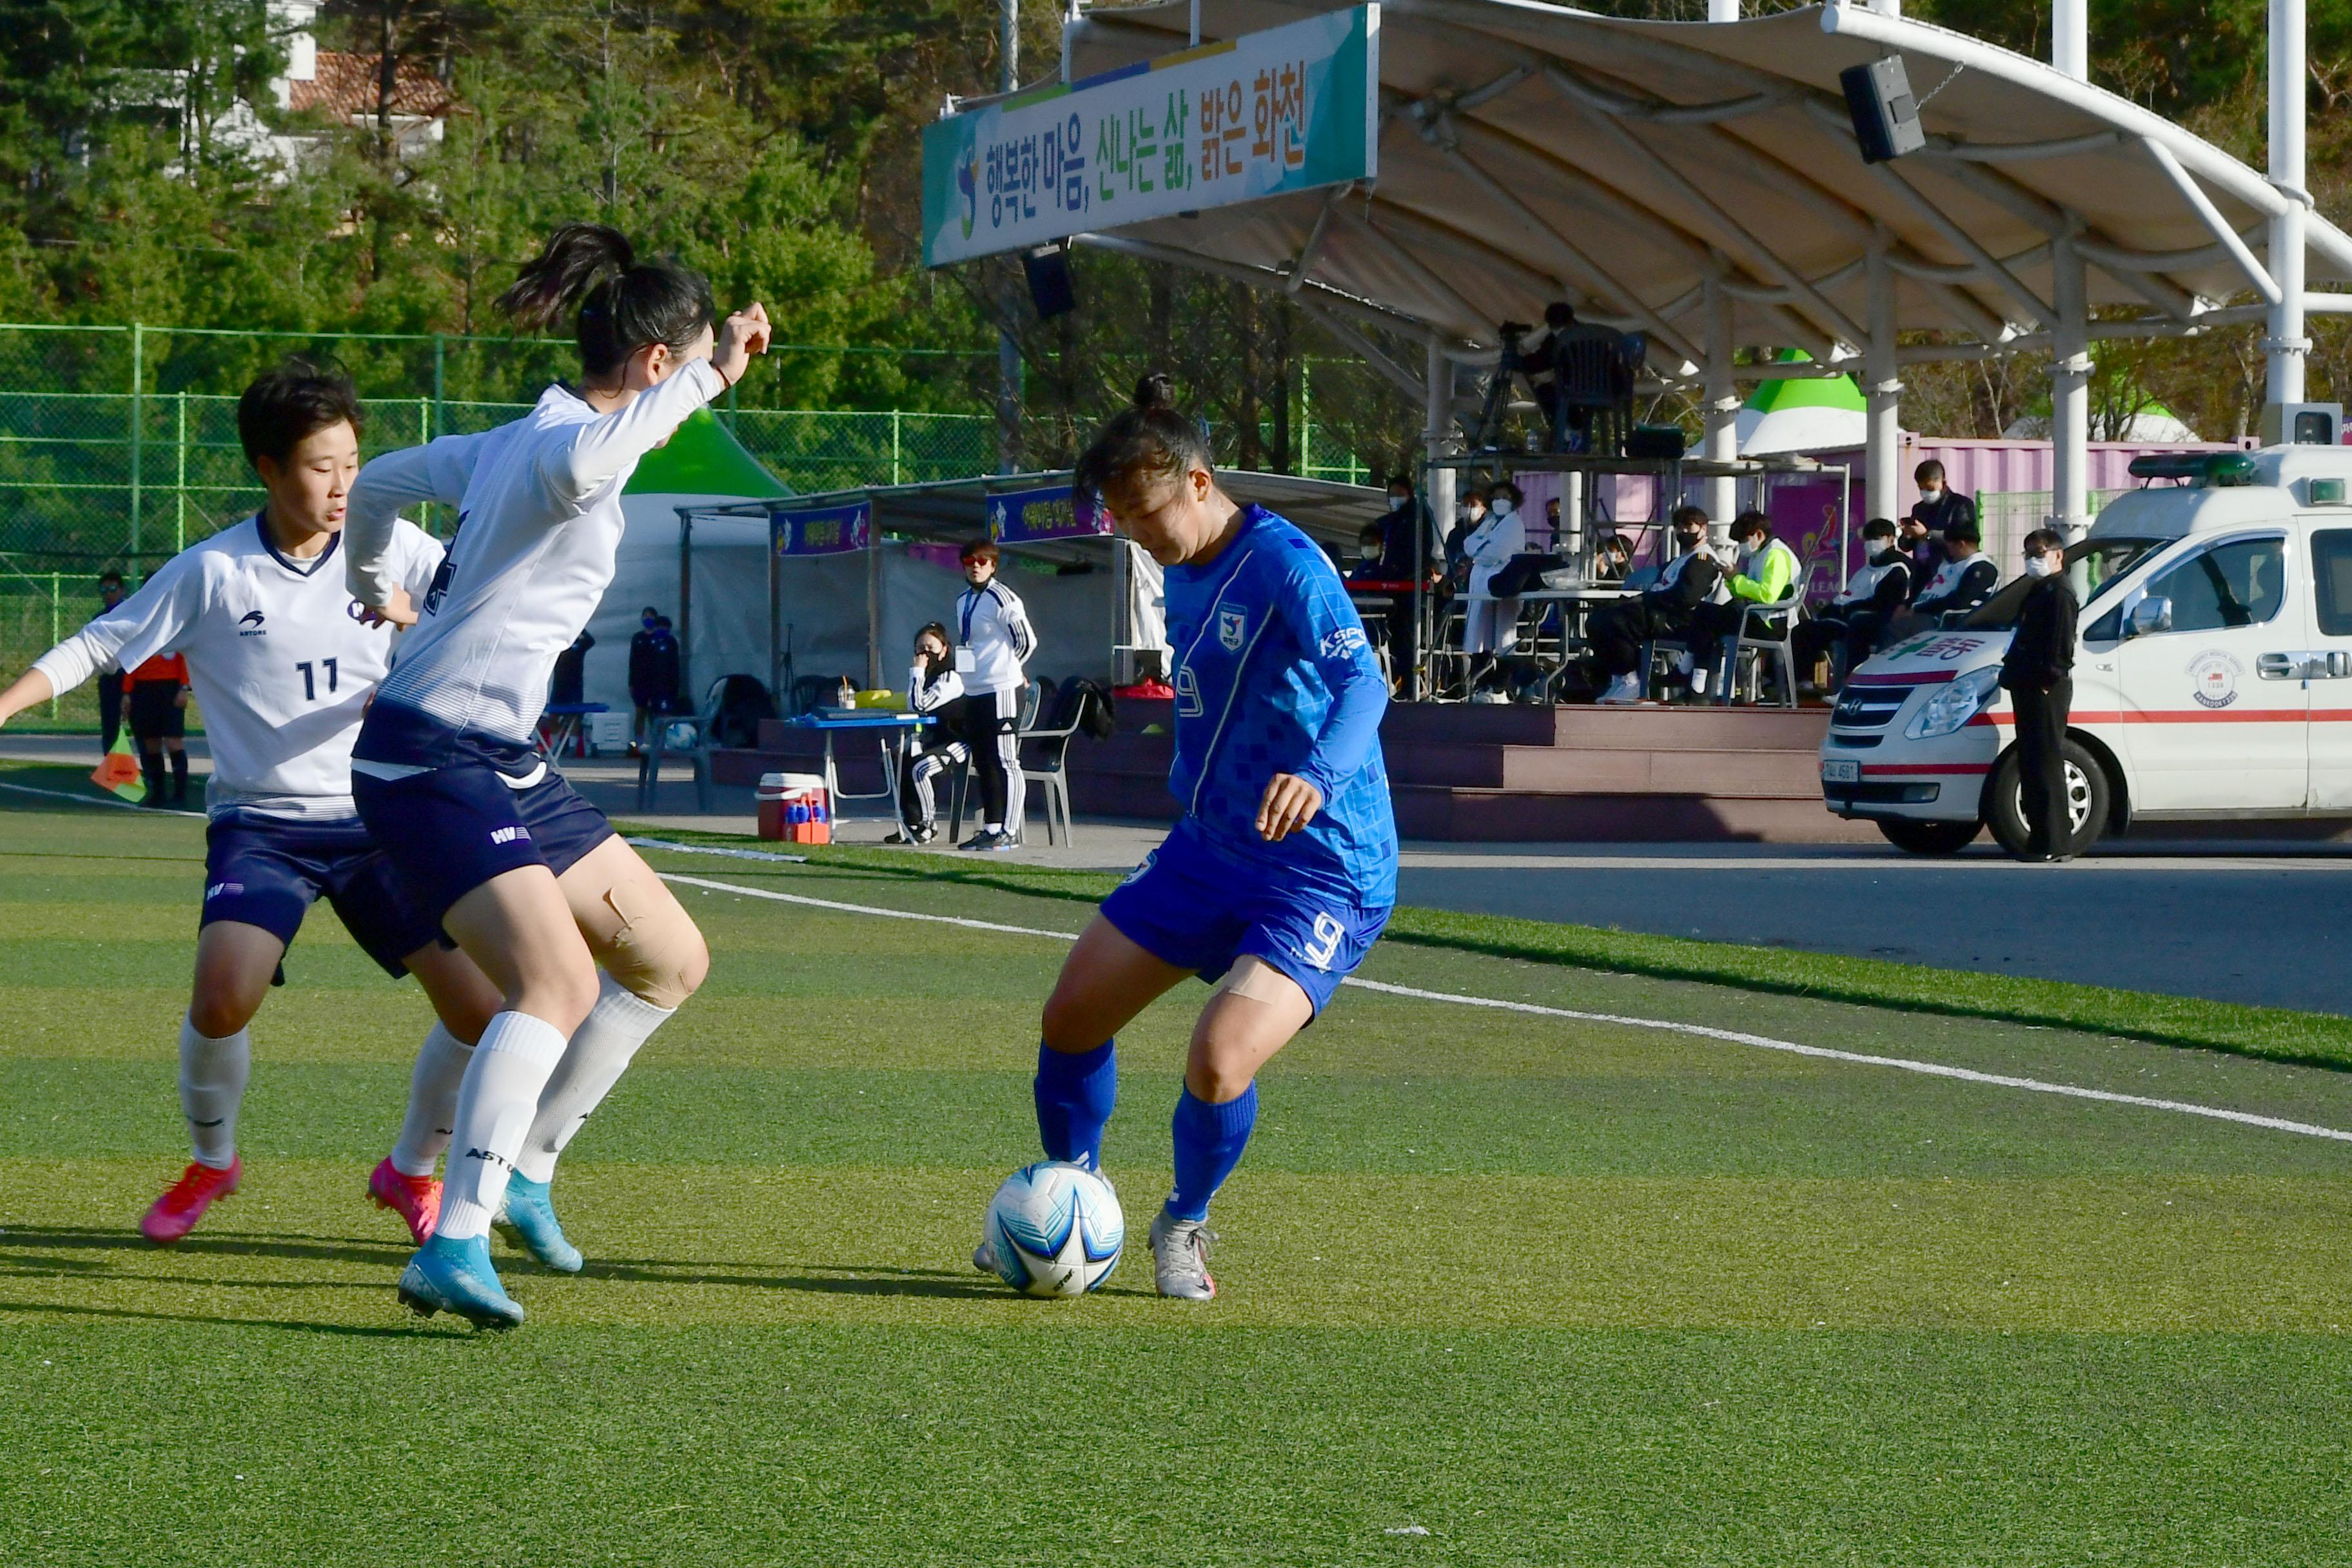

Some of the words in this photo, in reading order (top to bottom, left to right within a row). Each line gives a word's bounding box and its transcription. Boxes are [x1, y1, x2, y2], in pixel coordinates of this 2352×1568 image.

[986, 134, 1039, 228] 행복한
[1043, 112, 1090, 213] 마음,
[1095, 107, 1158, 201] 신나는
[1163, 88, 1193, 191] 삶,
[1200, 80, 1247, 181] 밝은
[1251, 60, 1306, 166] 화천
[295, 656, 338, 701] 11
[1304, 911, 1346, 971] 9
